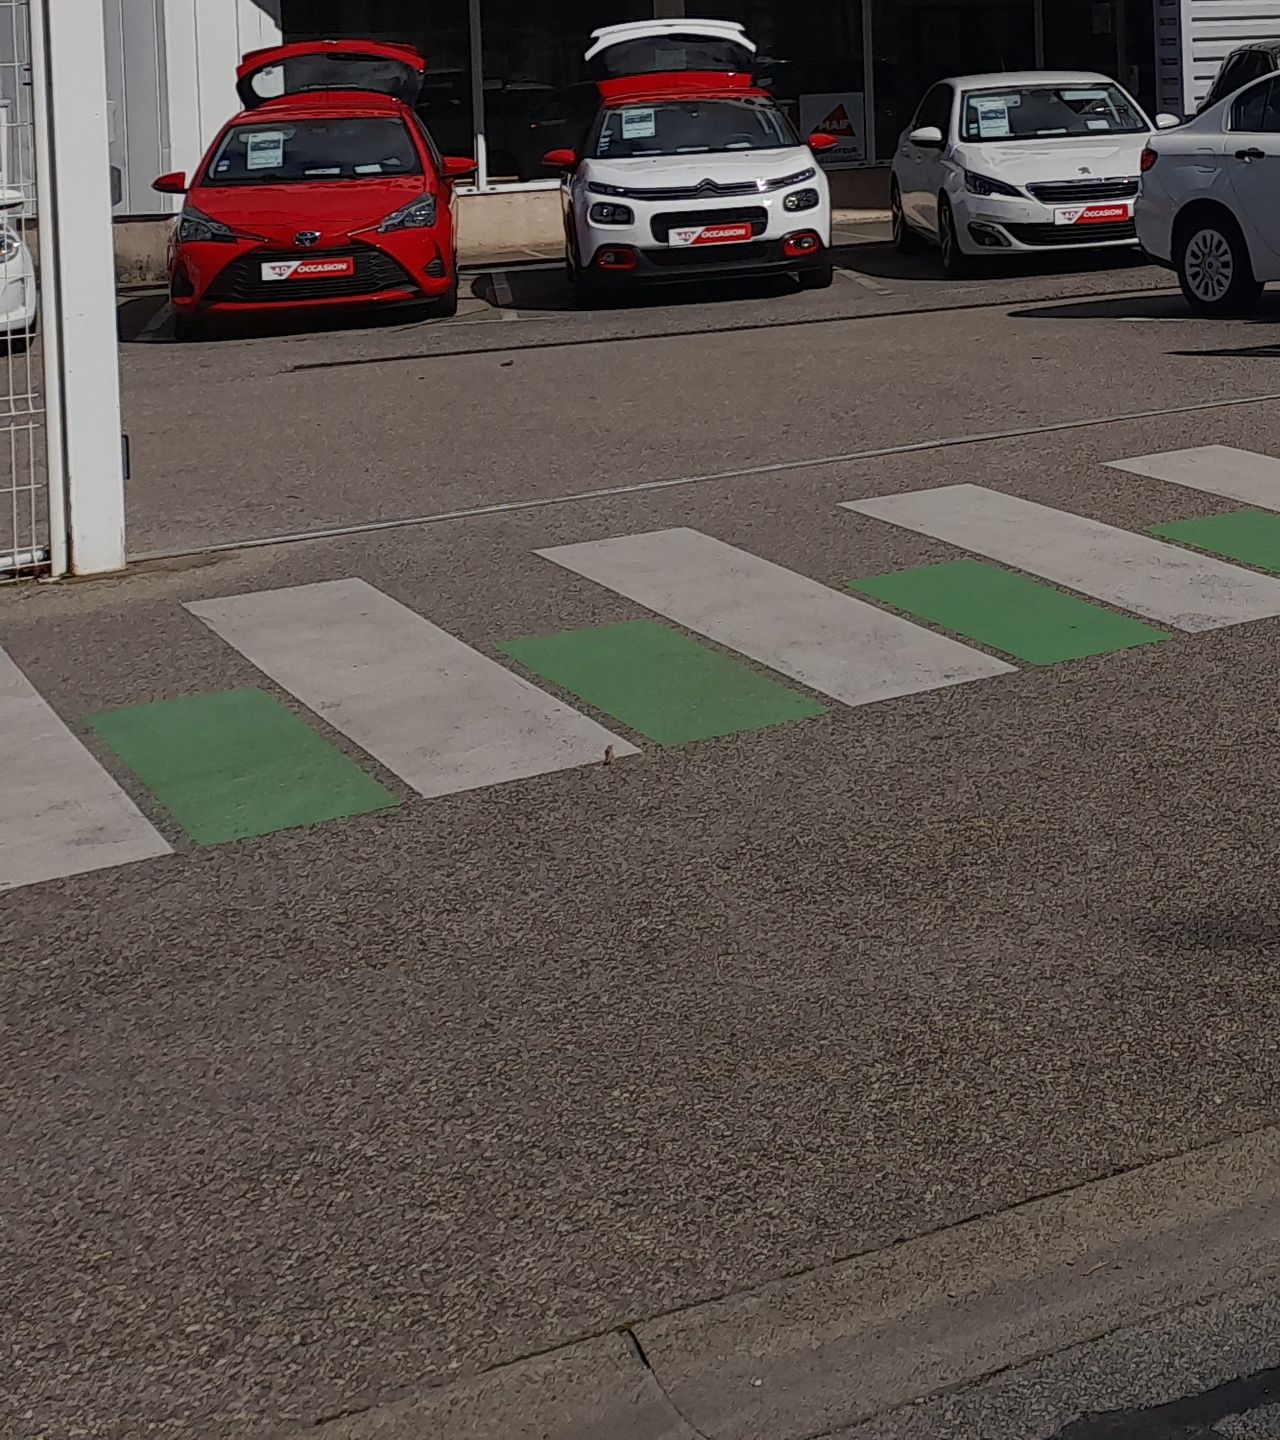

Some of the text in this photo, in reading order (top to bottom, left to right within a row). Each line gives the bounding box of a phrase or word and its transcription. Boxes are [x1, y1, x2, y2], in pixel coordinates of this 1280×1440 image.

[819, 119, 857, 131] MAIF
[1083, 208, 1124, 218] OCCASION
[701, 228, 746, 239] OCCASION
[297, 262, 348, 273] OCCASION
